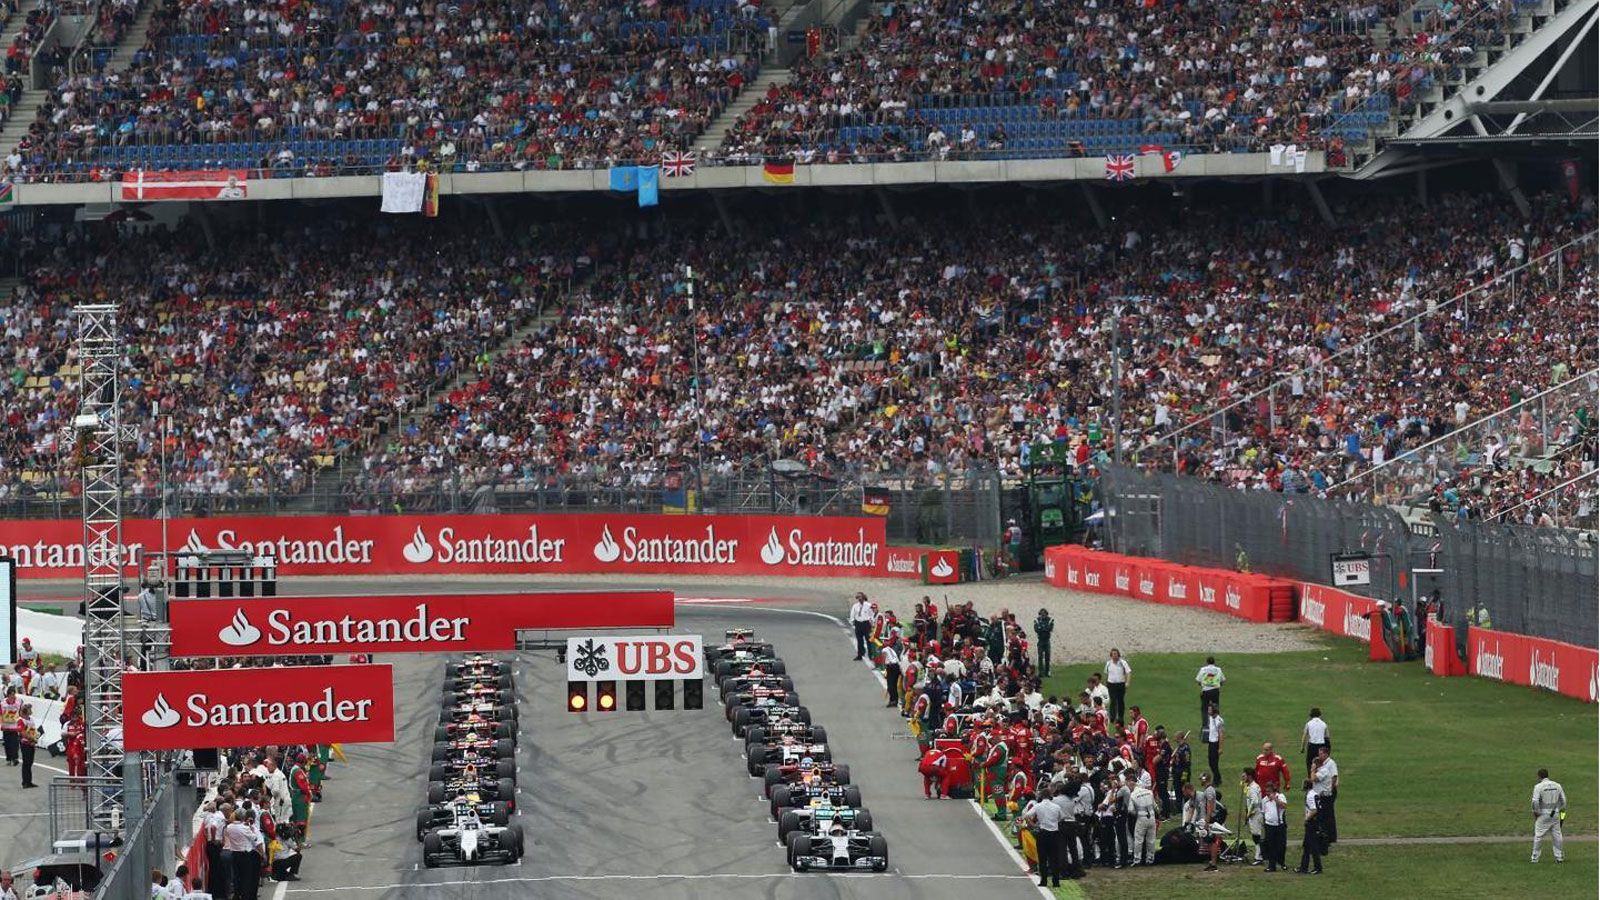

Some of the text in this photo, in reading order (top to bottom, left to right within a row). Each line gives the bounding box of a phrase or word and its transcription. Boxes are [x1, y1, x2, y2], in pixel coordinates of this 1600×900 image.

[0, 529, 142, 568] ntander
[437, 523, 565, 563] Santander
[623, 524, 738, 564] Santander
[787, 527, 878, 567] Santander
[1347, 561, 1369, 573] UBS
[268, 603, 470, 645] Santander
[614, 640, 697, 675] UBS
[187, 687, 372, 728] Santander
